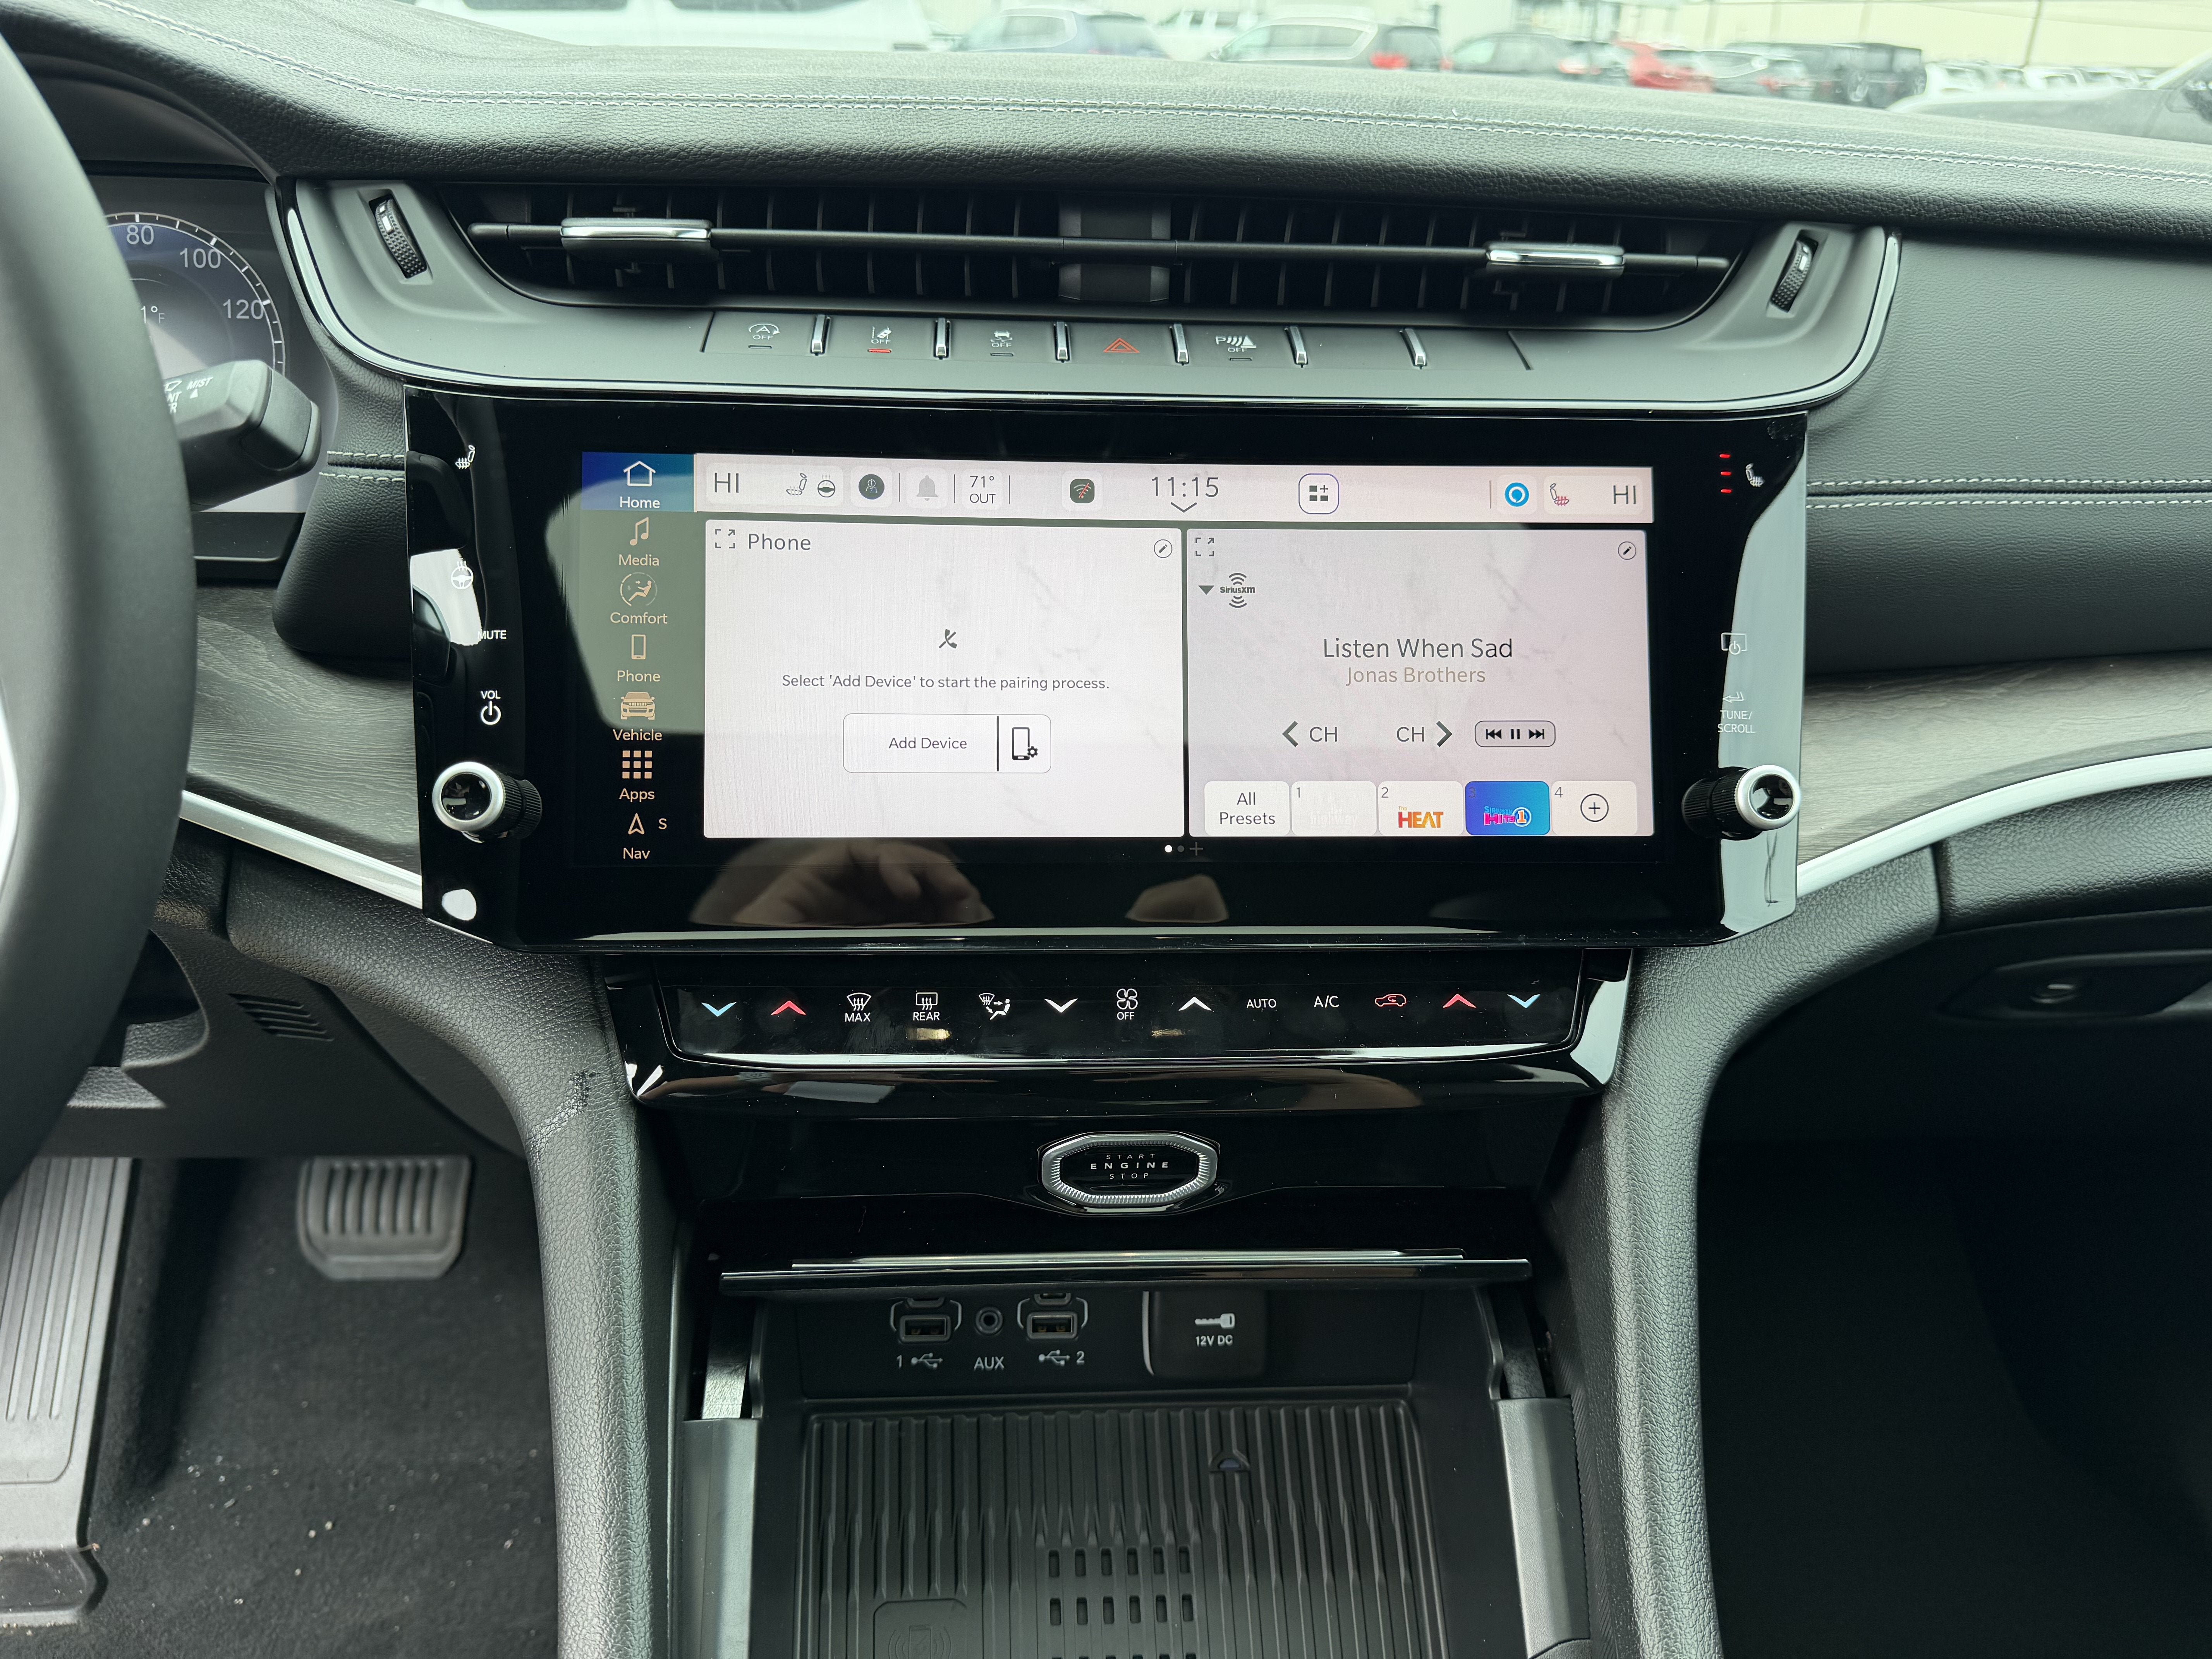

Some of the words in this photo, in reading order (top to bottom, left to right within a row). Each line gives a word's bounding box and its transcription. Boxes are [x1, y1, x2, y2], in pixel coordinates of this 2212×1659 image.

[126, 225, 154, 245] 80
[180, 248, 221, 268] 100
[223, 299, 264, 319] 120
[187, 377, 213, 390] MIST
[714, 472, 740, 494] HI
[1151, 476, 1219, 498] 11:15
[970, 493, 996, 504] OUT
[1613, 485, 1636, 505] HI
[620, 496, 660, 509] Home
[749, 533, 811, 551] Phone
[618, 554, 659, 566] Media
[610, 613, 668, 625] Comfort
[477, 630, 507, 640] MUTE
[1323, 638, 1389, 658] Listen
[1397, 638, 1464, 658] When
[1471, 638, 1513, 658] Sad
[617, 670, 660, 682] Phone
[782, 674, 824, 688] Select
[829, 674, 861, 688] 'Add
[865, 675, 916, 688] Device'
[919, 677, 934, 688] to
[938, 677, 970, 689] start
[974, 676, 997, 689] the
[1000, 676, 1048, 691] pairing
[1052, 679, 1109, 691] process.
[1346, 667, 1398, 686] Jonas
[1403, 667, 1486, 683] Brothers
[481, 690, 501, 699] VOL
[1720, 711, 1752, 720] TUNE/
[613, 729, 662, 741] Vehicle
[1309, 726, 1338, 742] CH
[1396, 726, 1425, 742] CH
[1717, 724, 1755, 733] SCROLL
[888, 737, 916, 749] Add
[921, 737, 967, 750] Device
[619, 788, 655, 802] Apps
[1237, 792, 1256, 805] All
[1296, 787, 1301, 798] 1
[1381, 787, 1389, 798] 2
[1469, 787, 1475, 798] 3
[1554, 787, 1563, 798] 4
[658, 818, 667, 830] S
[1220, 812, 1275, 825] Presets
[1398, 811, 1444, 828] HEAT
[623, 848, 650, 859] Nav
[1247, 999, 1276, 1008] AUTO
[1314, 996, 1339, 1008] A/C
[845, 1013, 871, 1022] MAX
[913, 1012, 940, 1022] REAR
[1117, 1012, 1134, 1020] OFF
[1195, 1336, 1214, 1346] 12V
[1217, 1335, 1233, 1345] DC
[897, 1355, 902, 1368] 1
[974, 1357, 1005, 1370] AUX
[1076, 1352, 1084, 1365] 2
